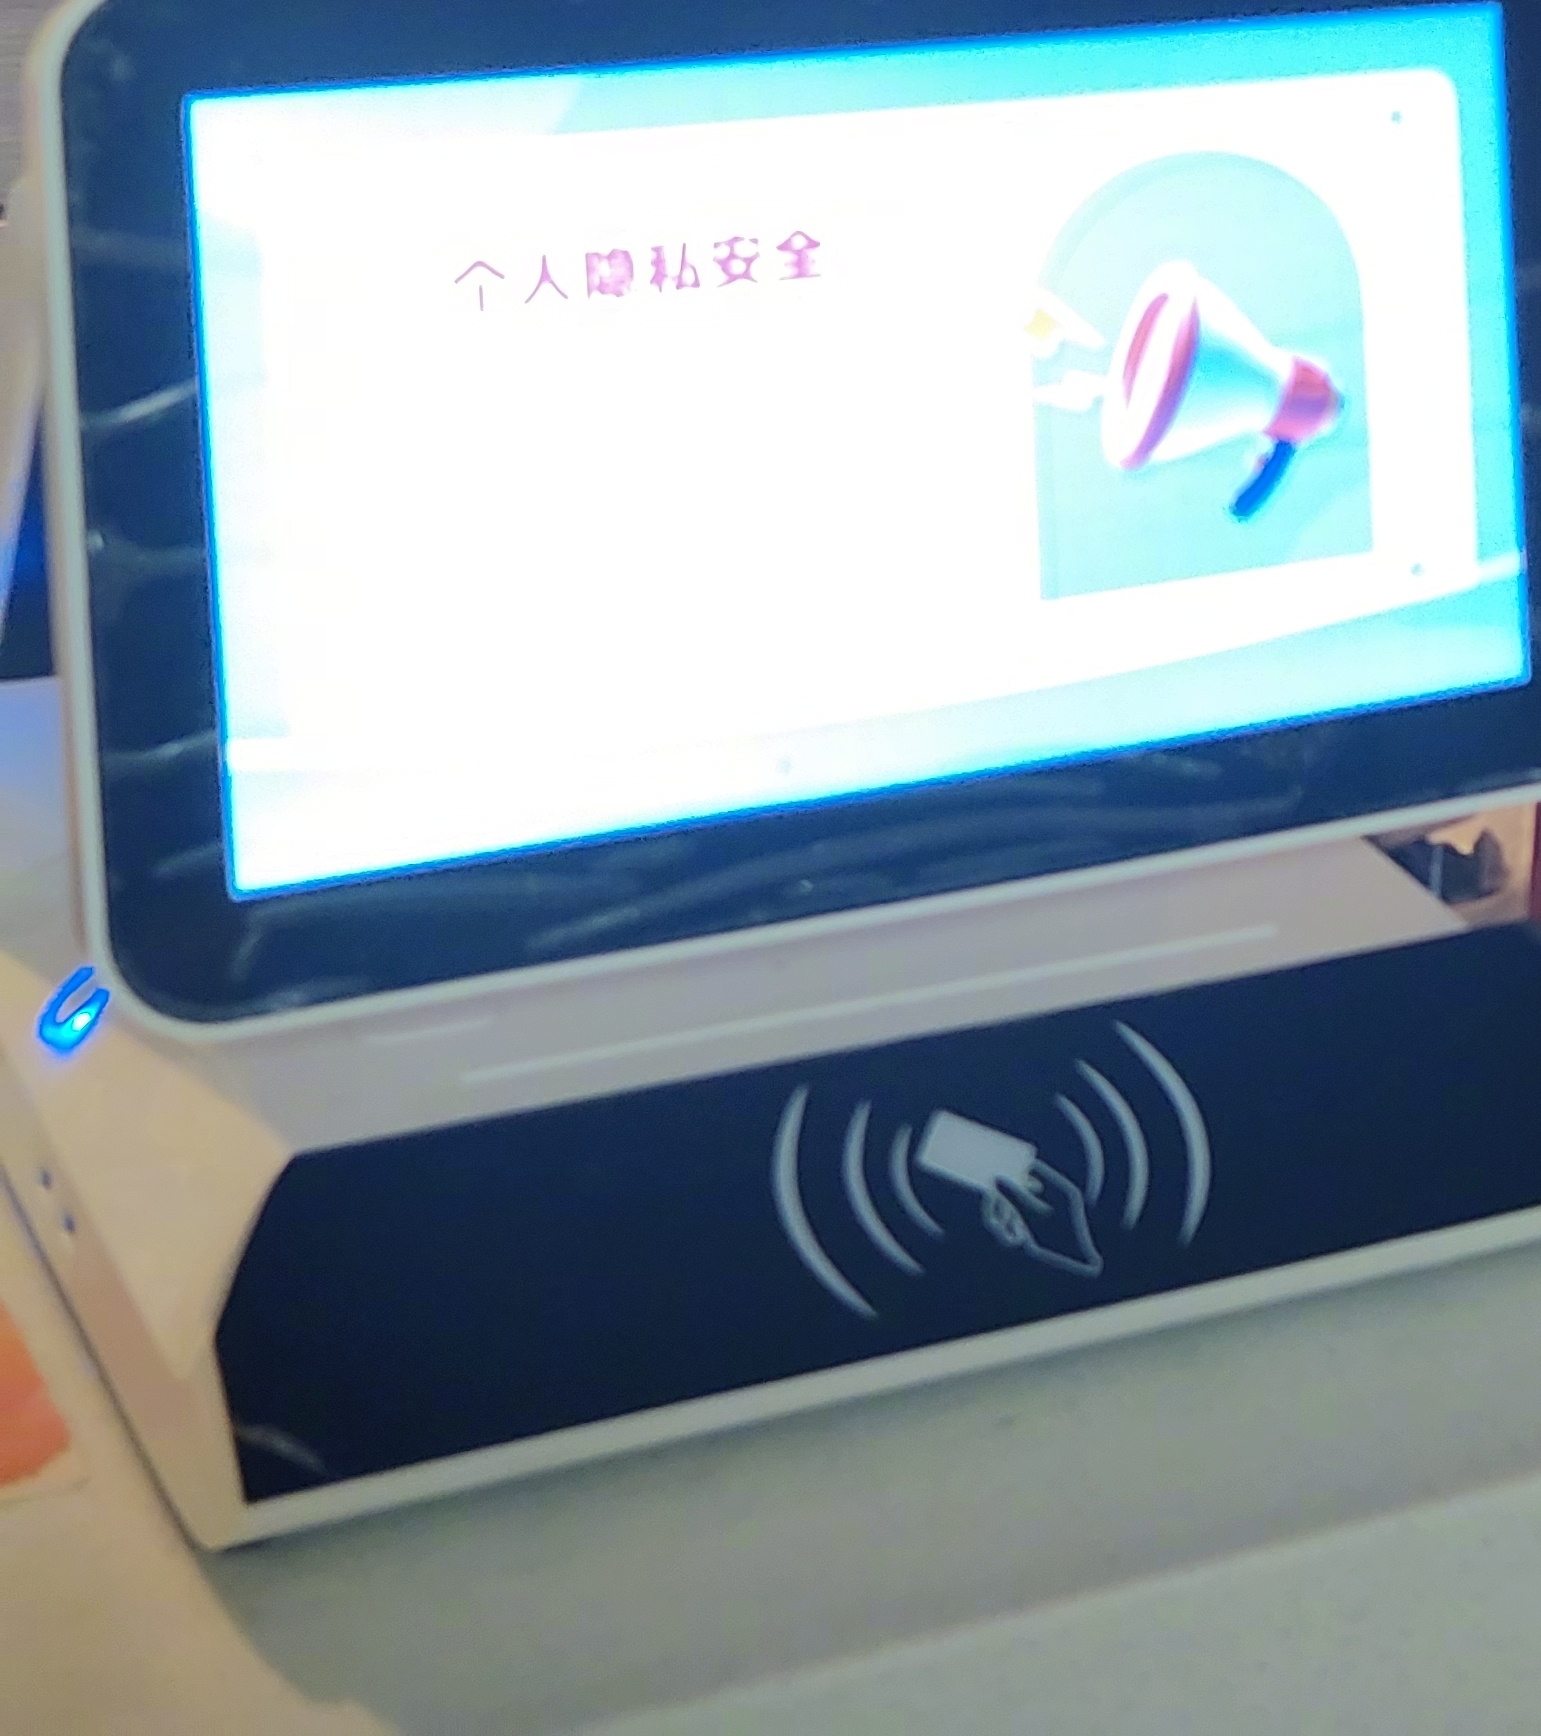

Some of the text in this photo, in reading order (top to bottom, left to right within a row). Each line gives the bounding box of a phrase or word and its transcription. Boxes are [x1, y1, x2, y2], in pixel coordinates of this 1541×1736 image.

[455, 230, 821, 312] 个人隐私安全
